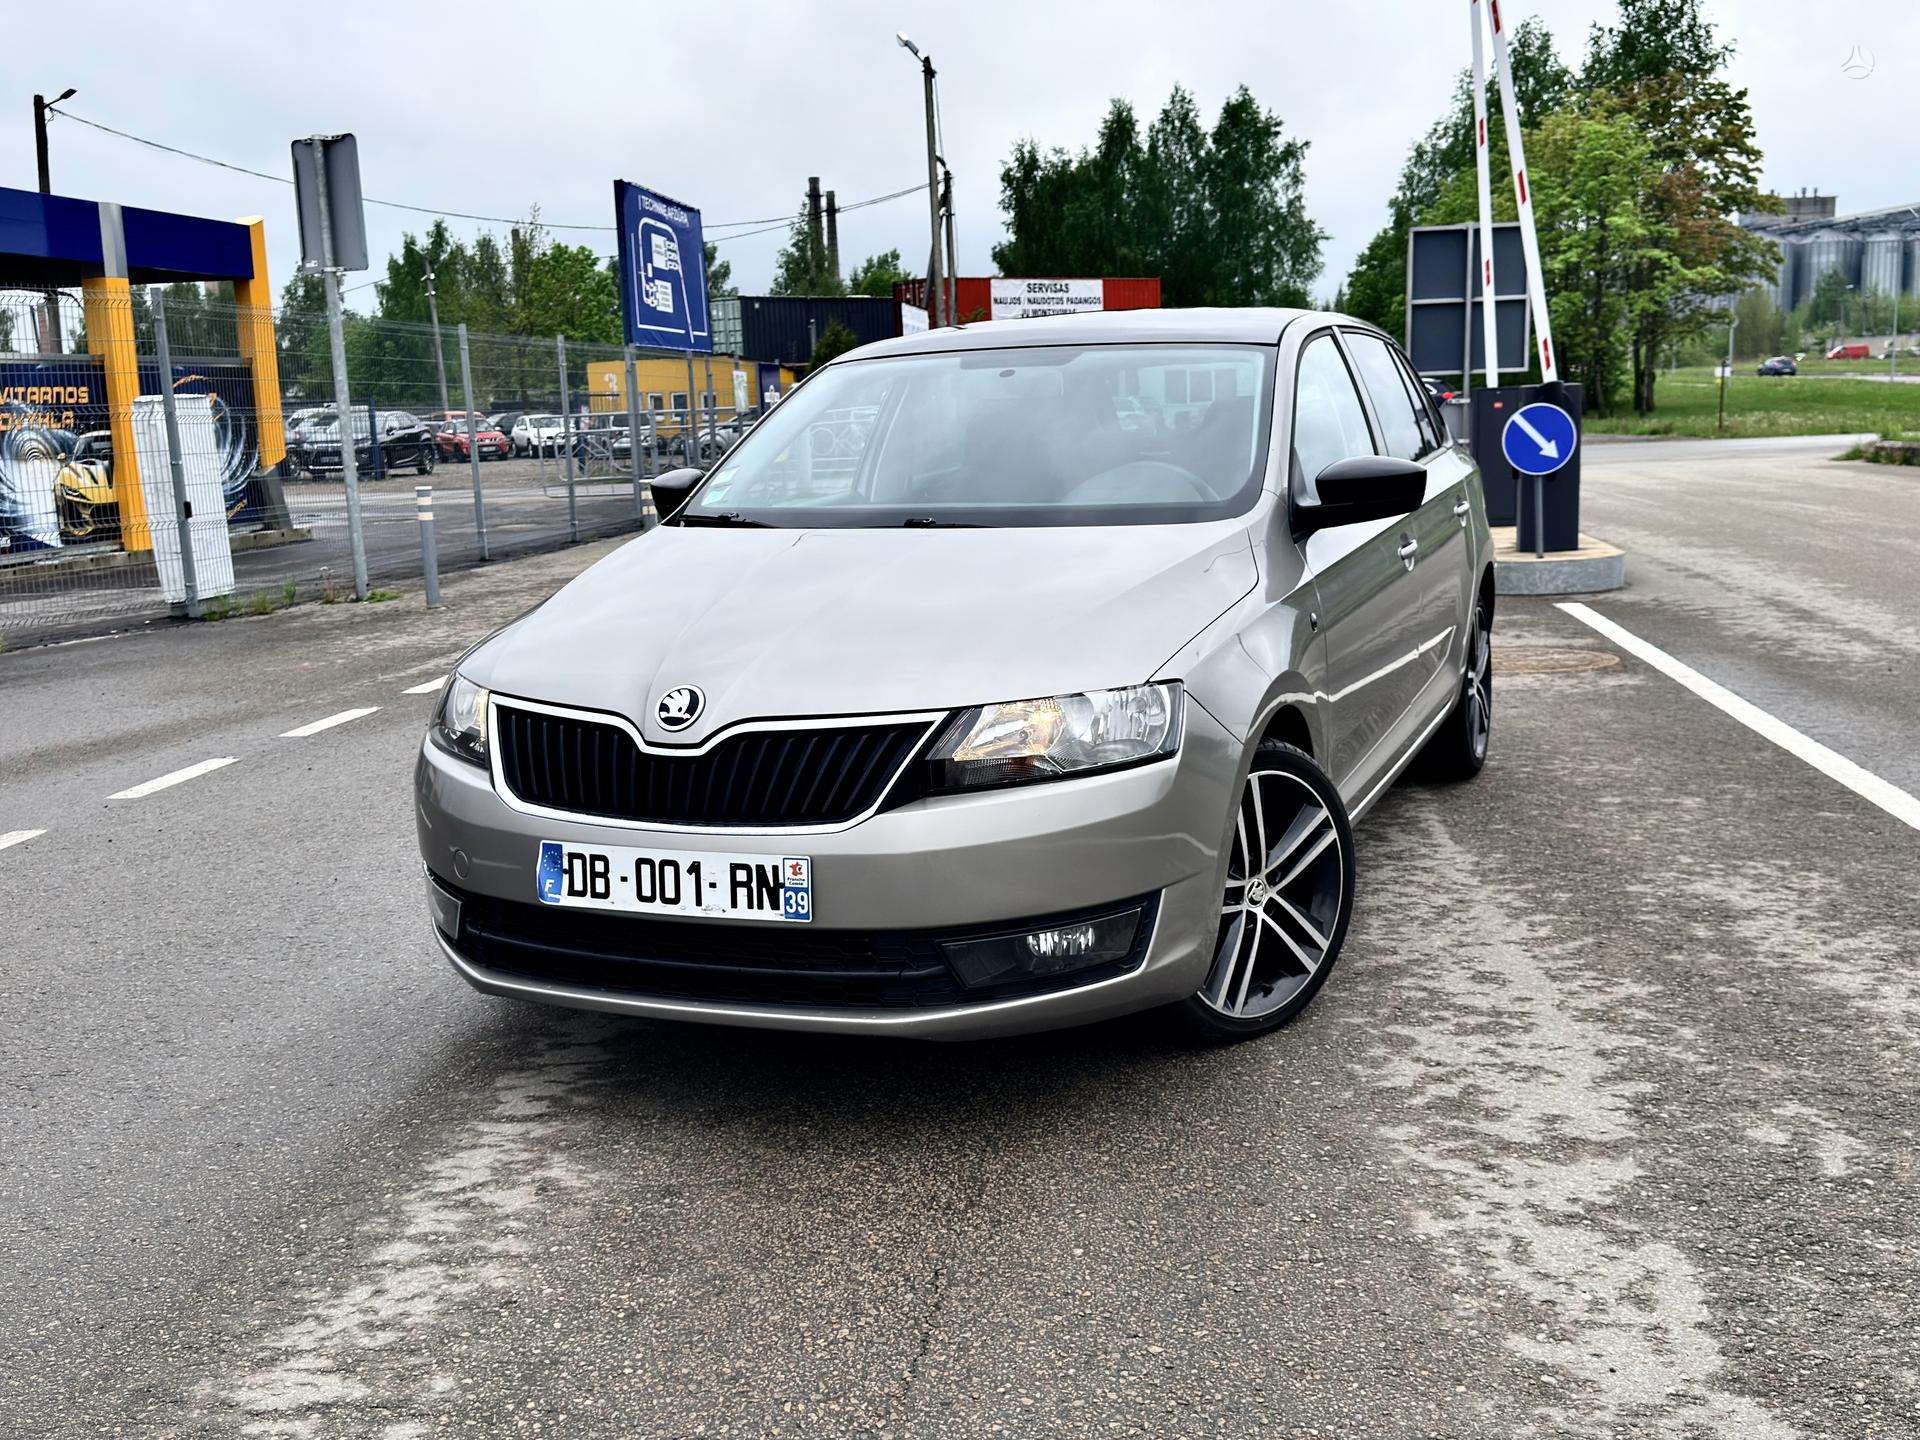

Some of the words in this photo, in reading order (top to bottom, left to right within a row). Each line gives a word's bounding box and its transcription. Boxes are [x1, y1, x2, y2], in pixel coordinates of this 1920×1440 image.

[1026, 283, 1070, 293] SERVISAS
[993, 297, 1021, 305] NAUJOS
[544, 879, 555, 892] F
[785, 891, 809, 914] 39
